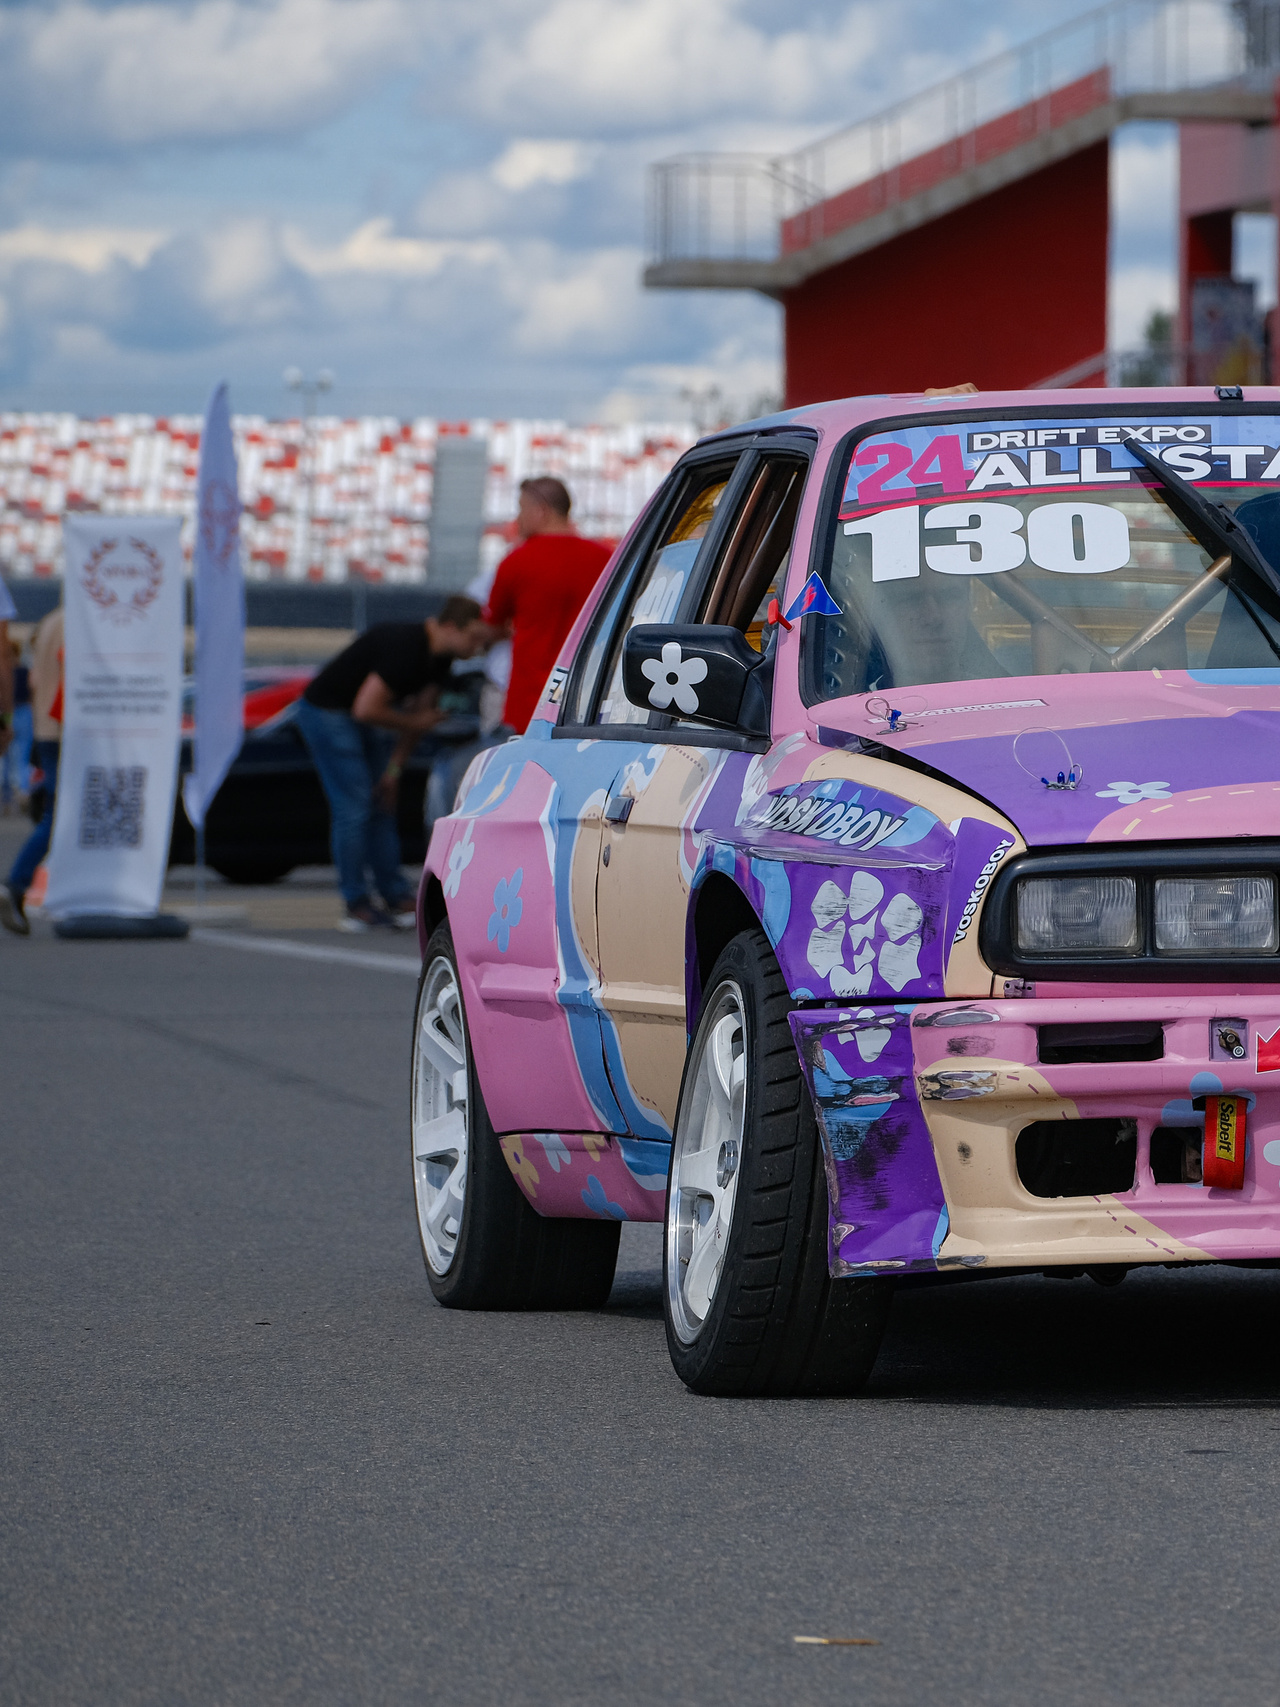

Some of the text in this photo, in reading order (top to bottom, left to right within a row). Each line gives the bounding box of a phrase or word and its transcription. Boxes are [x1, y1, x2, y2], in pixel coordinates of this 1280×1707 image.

[973, 426, 1206, 450] DRIFT EXPO
[855, 434, 975, 505] 24
[967, 448, 1131, 490] ALL
[843, 502, 1131, 583] 130
[953, 839, 1015, 943] VOSKOBOY
[1218, 1101, 1235, 1153] Sabelt
